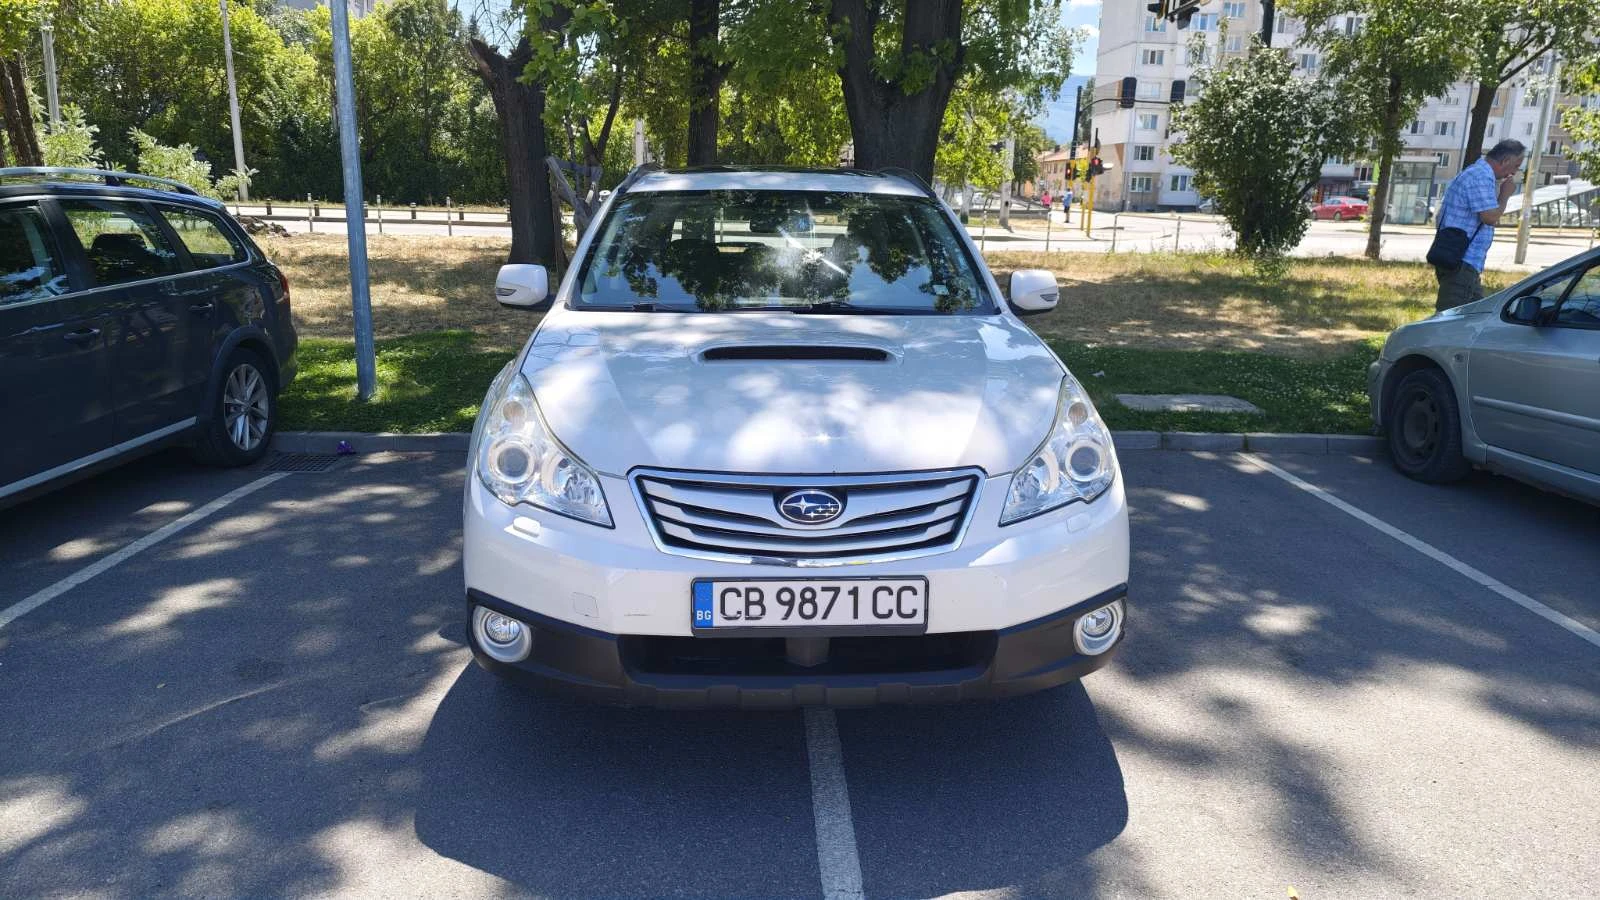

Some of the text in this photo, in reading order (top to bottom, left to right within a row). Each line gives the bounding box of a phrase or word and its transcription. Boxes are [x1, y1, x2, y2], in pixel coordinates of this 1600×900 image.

[720, 585, 918, 621] CB 9871 CC
[696, 610, 712, 620] BG
